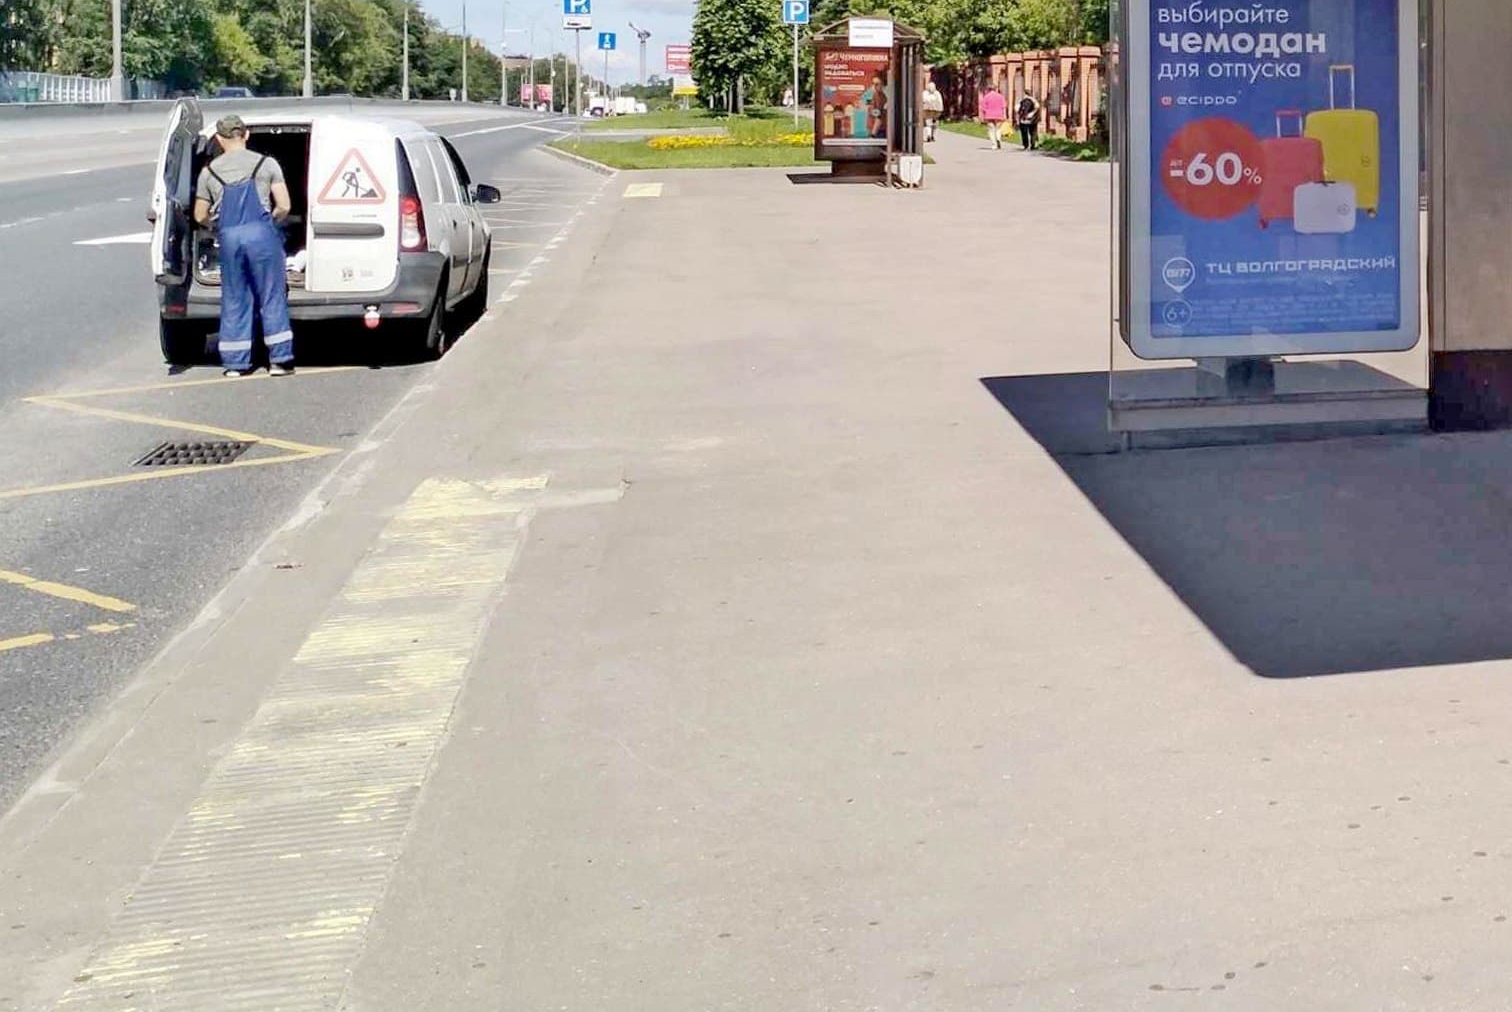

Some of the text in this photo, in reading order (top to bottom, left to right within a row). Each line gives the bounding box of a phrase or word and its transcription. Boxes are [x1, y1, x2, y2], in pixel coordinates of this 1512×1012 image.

[1158, 0, 1290, 29] выбирайте
[1158, 32, 1327, 59] чемодан
[1157, 61, 1301, 84] для отпуска
[1206, 262, 1232, 275] ТЦ
[1236, 255, 1395, 274] ВОЛГОГРАДСКИЙ
